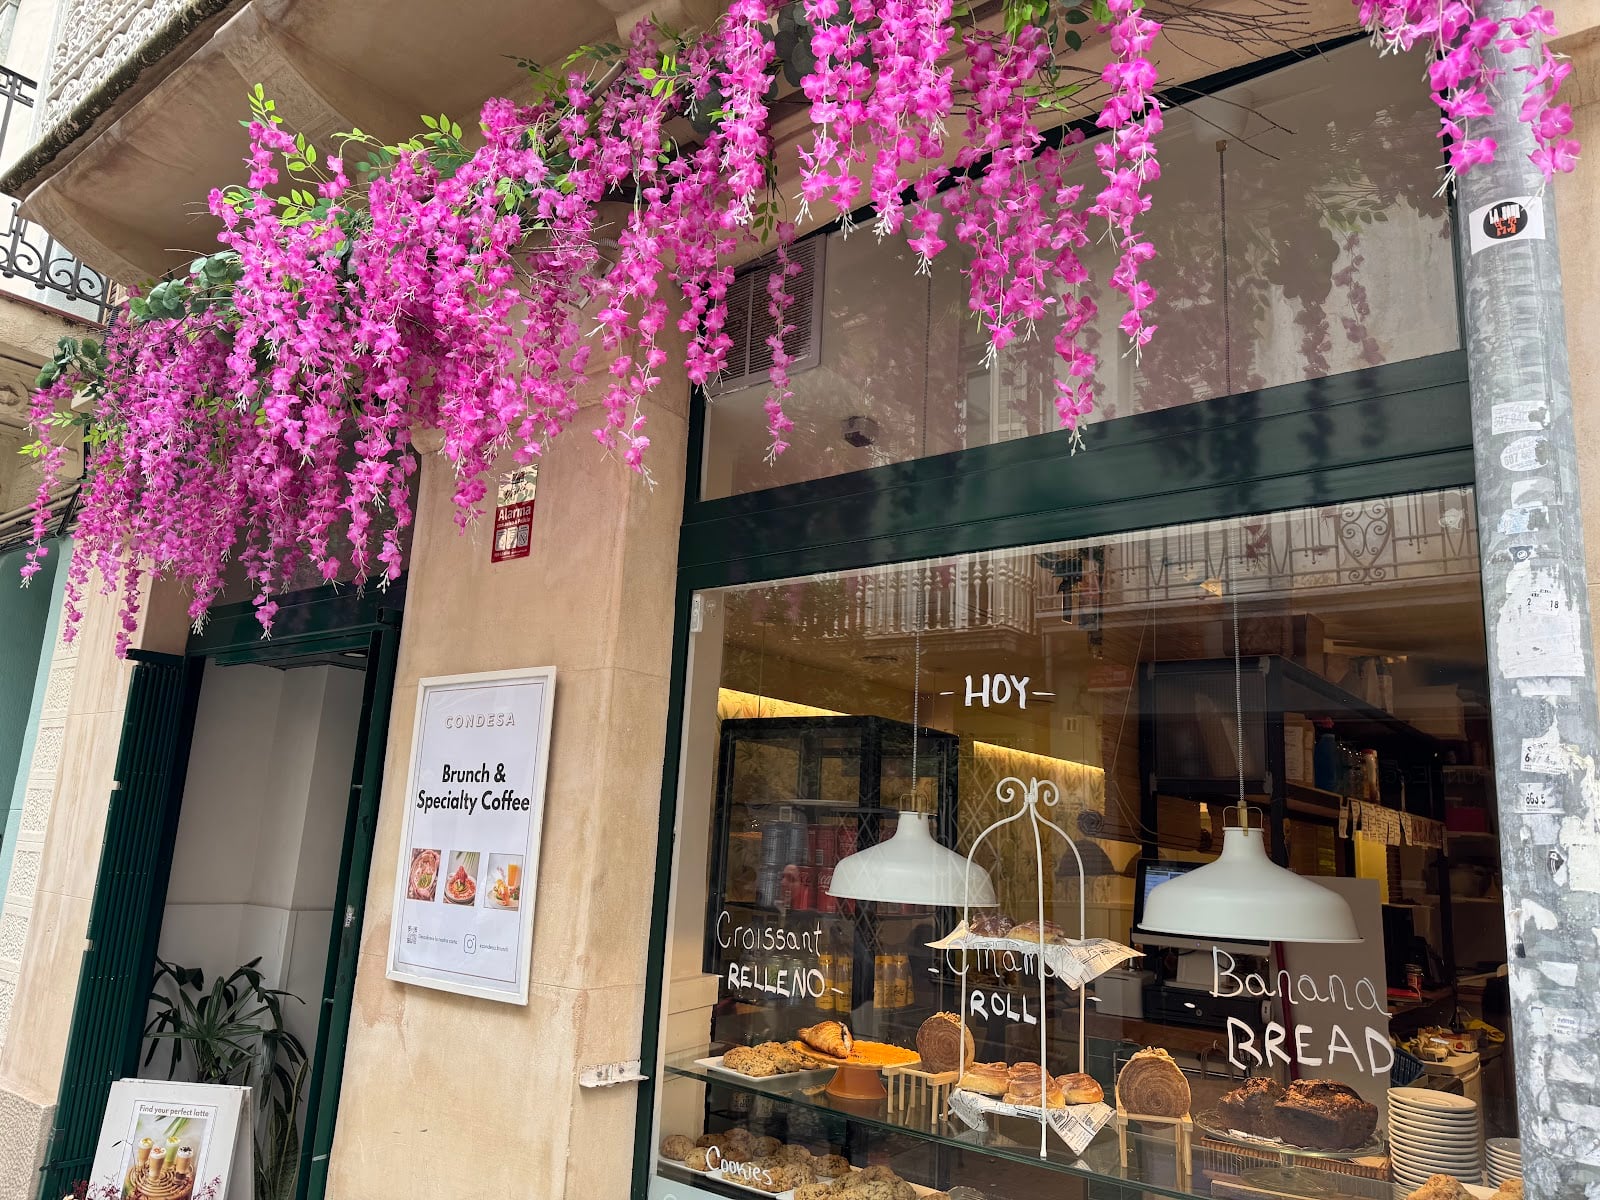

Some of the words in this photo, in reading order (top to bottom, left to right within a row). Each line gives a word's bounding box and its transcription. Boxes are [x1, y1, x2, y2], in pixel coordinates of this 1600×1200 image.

[498, 506, 531, 521] Alarma
[965, 673, 1030, 709] HOY
[445, 712, 516, 729] CONDESA
[441, 762, 490, 783] Brunch
[493, 762, 506, 783] &
[416, 790, 478, 815] Specialty
[481, 789, 530, 811] Coffee
[716, 911, 823, 957] Croissant
[728, 962, 825, 1000] RELLENO
[1208, 946, 1393, 1018] Banana
[970, 989, 1037, 1025] ROLL
[1227, 1016, 1395, 1077] BREAD
[139, 1104, 153, 1113] Find
[154, 1106, 169, 1114] your
[169, 1107, 192, 1116] perfect
[193, 1108, 209, 1117] latte
[705, 1145, 773, 1186] Cookies
